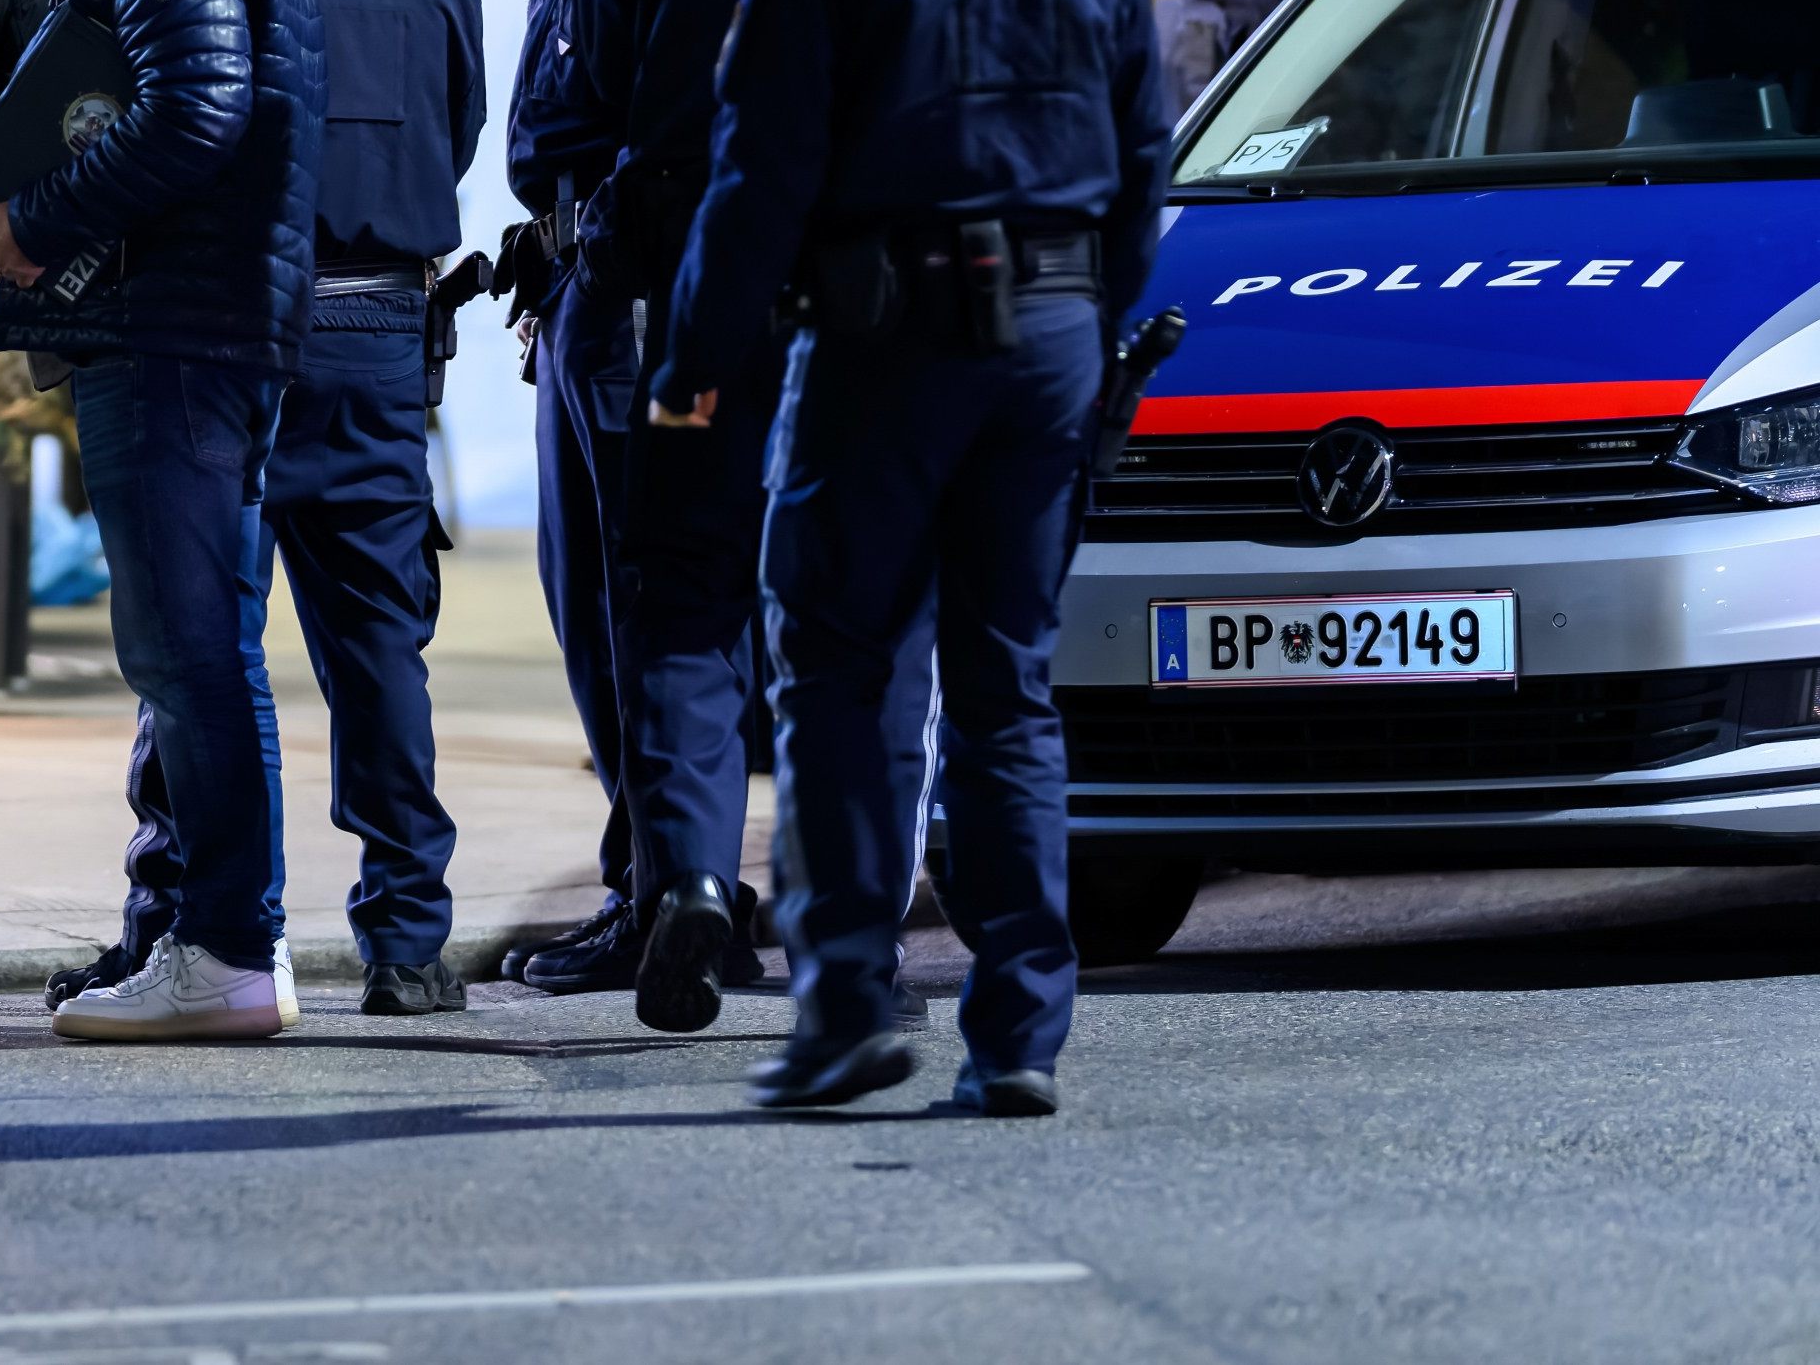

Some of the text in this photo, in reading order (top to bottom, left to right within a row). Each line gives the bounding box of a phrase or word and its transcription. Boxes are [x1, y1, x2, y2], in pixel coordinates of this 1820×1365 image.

[1211, 260, 1685, 305] POLIZEI
[1210, 607, 1480, 670] BP 92149
[1166, 653, 1180, 670] A
